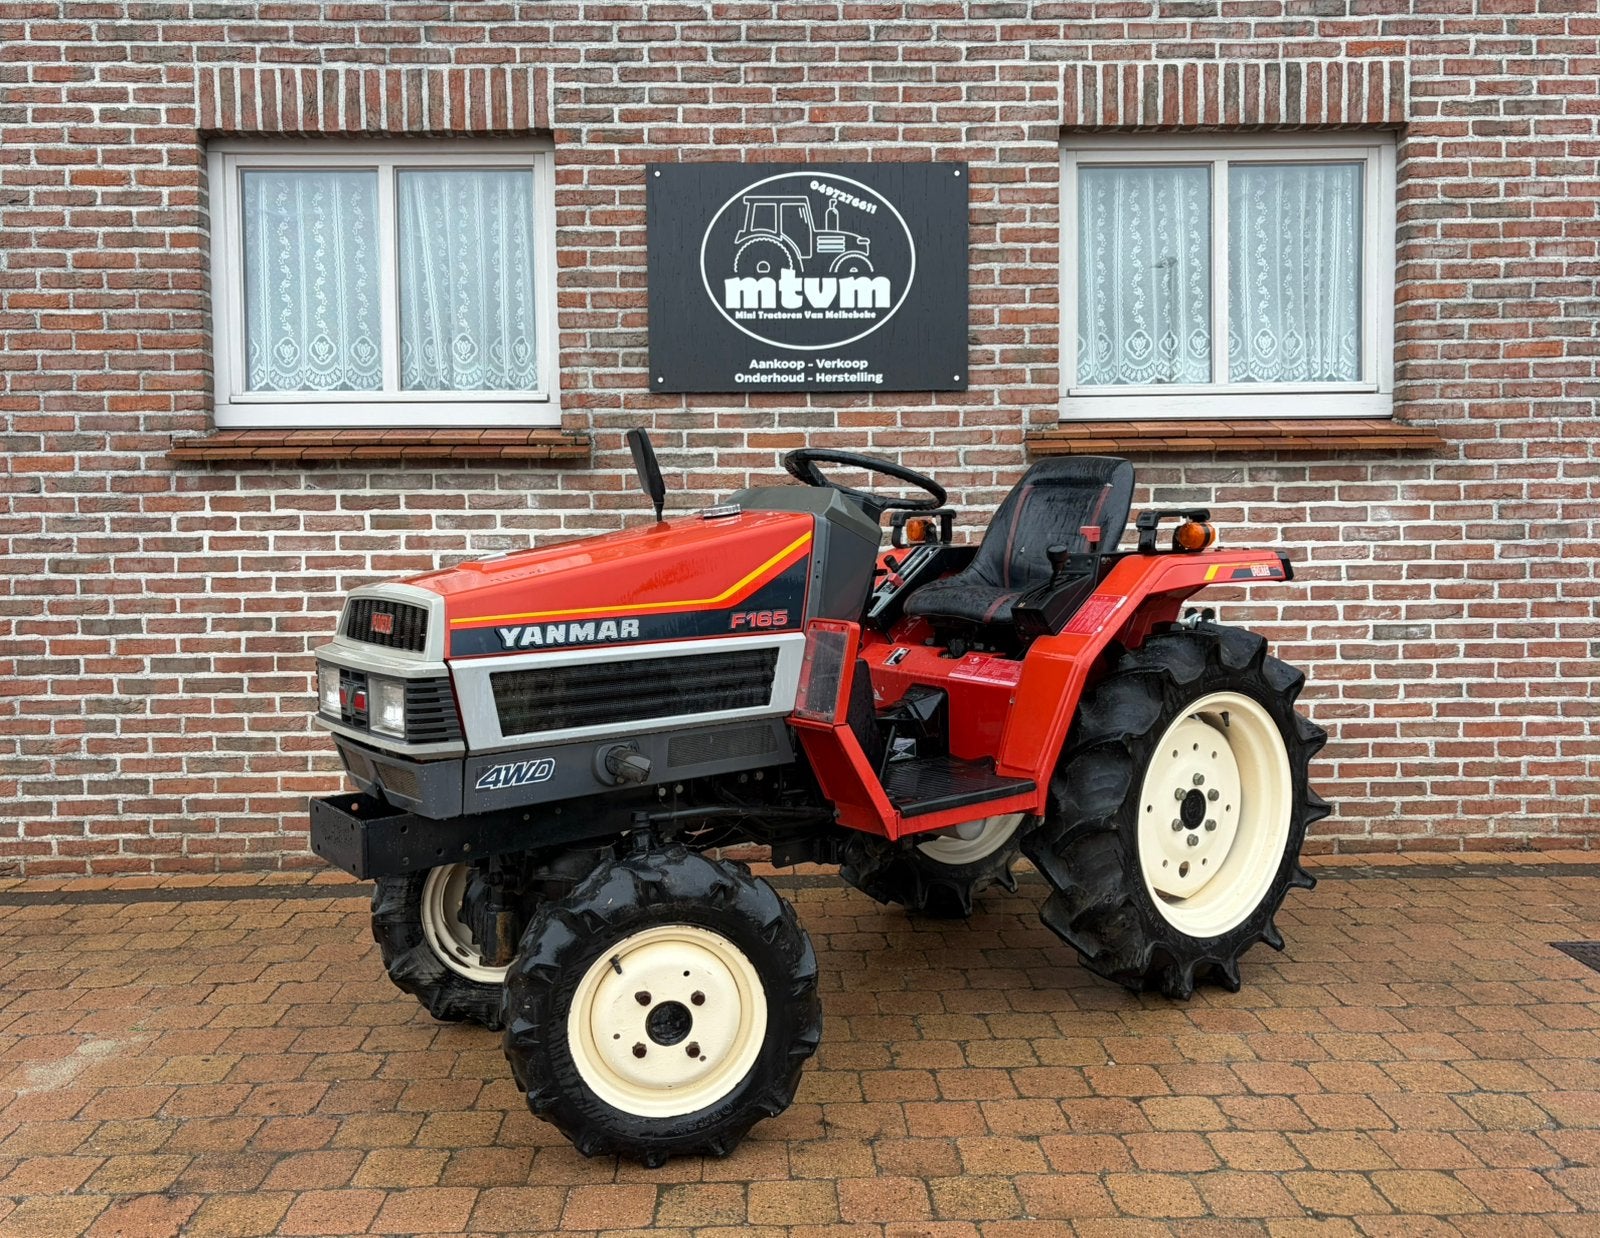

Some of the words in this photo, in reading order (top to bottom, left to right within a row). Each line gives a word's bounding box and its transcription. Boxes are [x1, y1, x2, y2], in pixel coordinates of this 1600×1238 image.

[810, 180, 877, 214] 0497276611
[725, 268, 891, 309] mtvm
[735, 311, 756, 319] Mini
[758, 311, 802, 319] Tractoren
[804, 310, 824, 319] Van
[749, 359, 805, 370] Aankoop
[816, 358, 868, 370] Verkoop
[734, 372, 805, 383] Onderhoud
[816, 372, 883, 384] Herstelling
[731, 609, 788, 629] F165
[499, 618, 640, 648] YANMAR
[475, 758, 556, 790] 4WD
